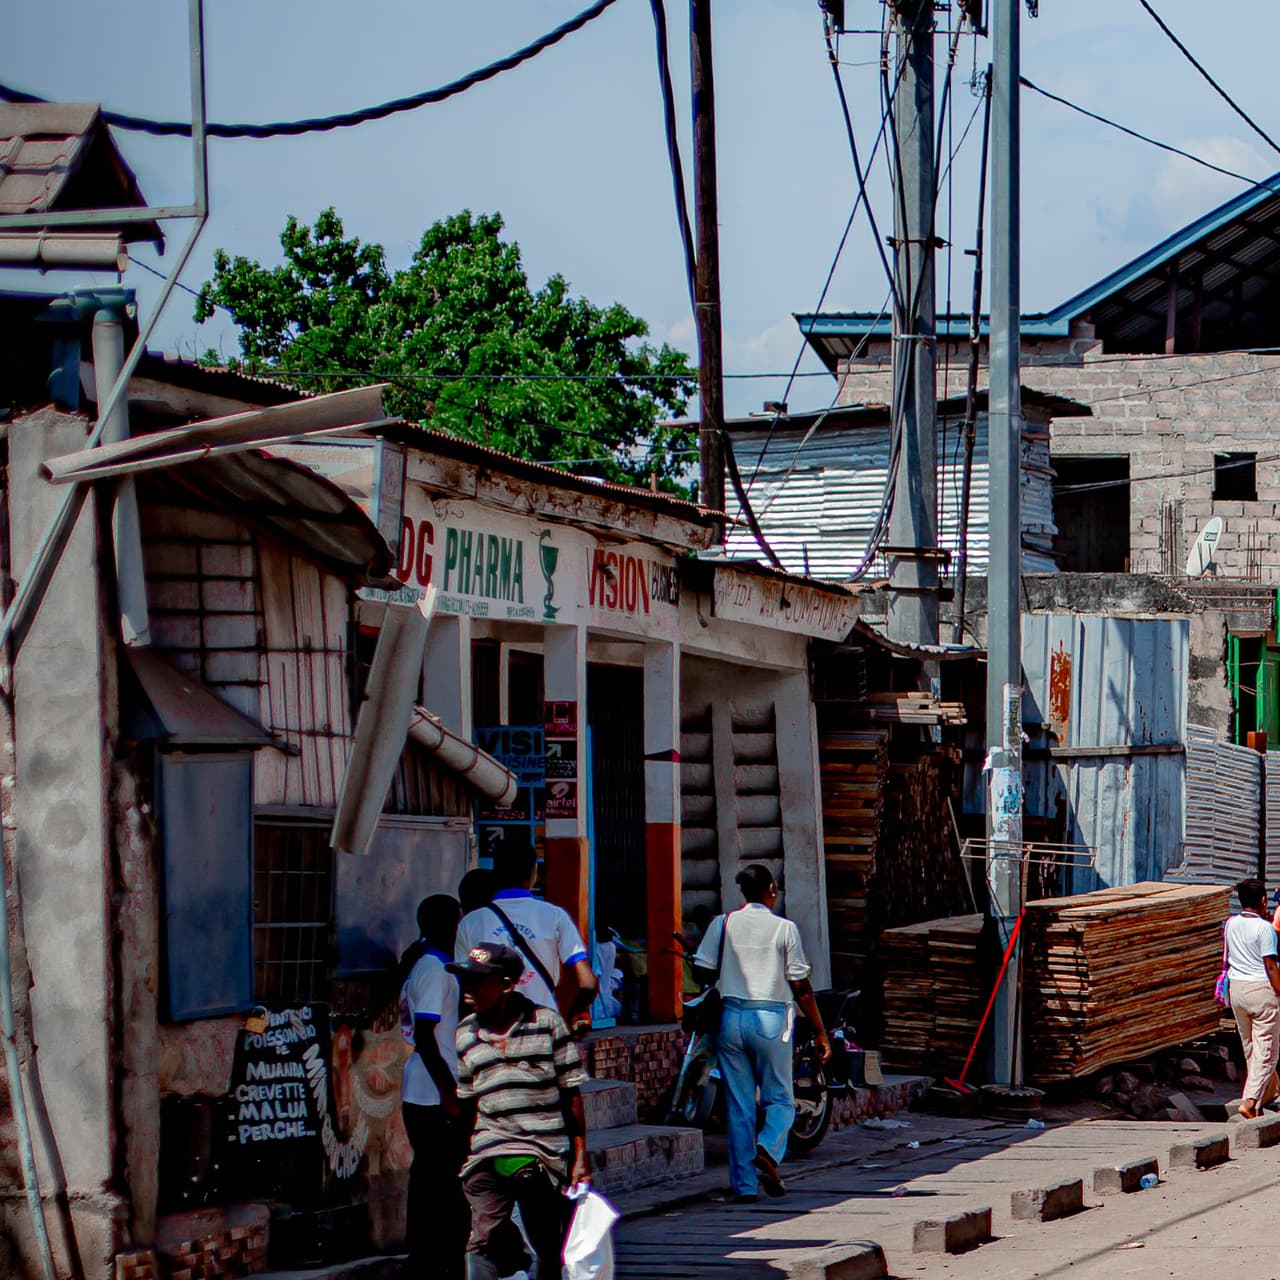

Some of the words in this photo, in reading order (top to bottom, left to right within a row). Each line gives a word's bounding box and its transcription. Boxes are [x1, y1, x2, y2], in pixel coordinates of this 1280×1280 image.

[443, 527, 524, 604] PHARMA
[586, 546, 650, 614] VISION
[497, 755, 544, 769] USINE
[244, 1027, 299, 1051] POISSON
[275, 1046, 291, 1055] DE
[246, 1061, 306, 1081] MUANDA
